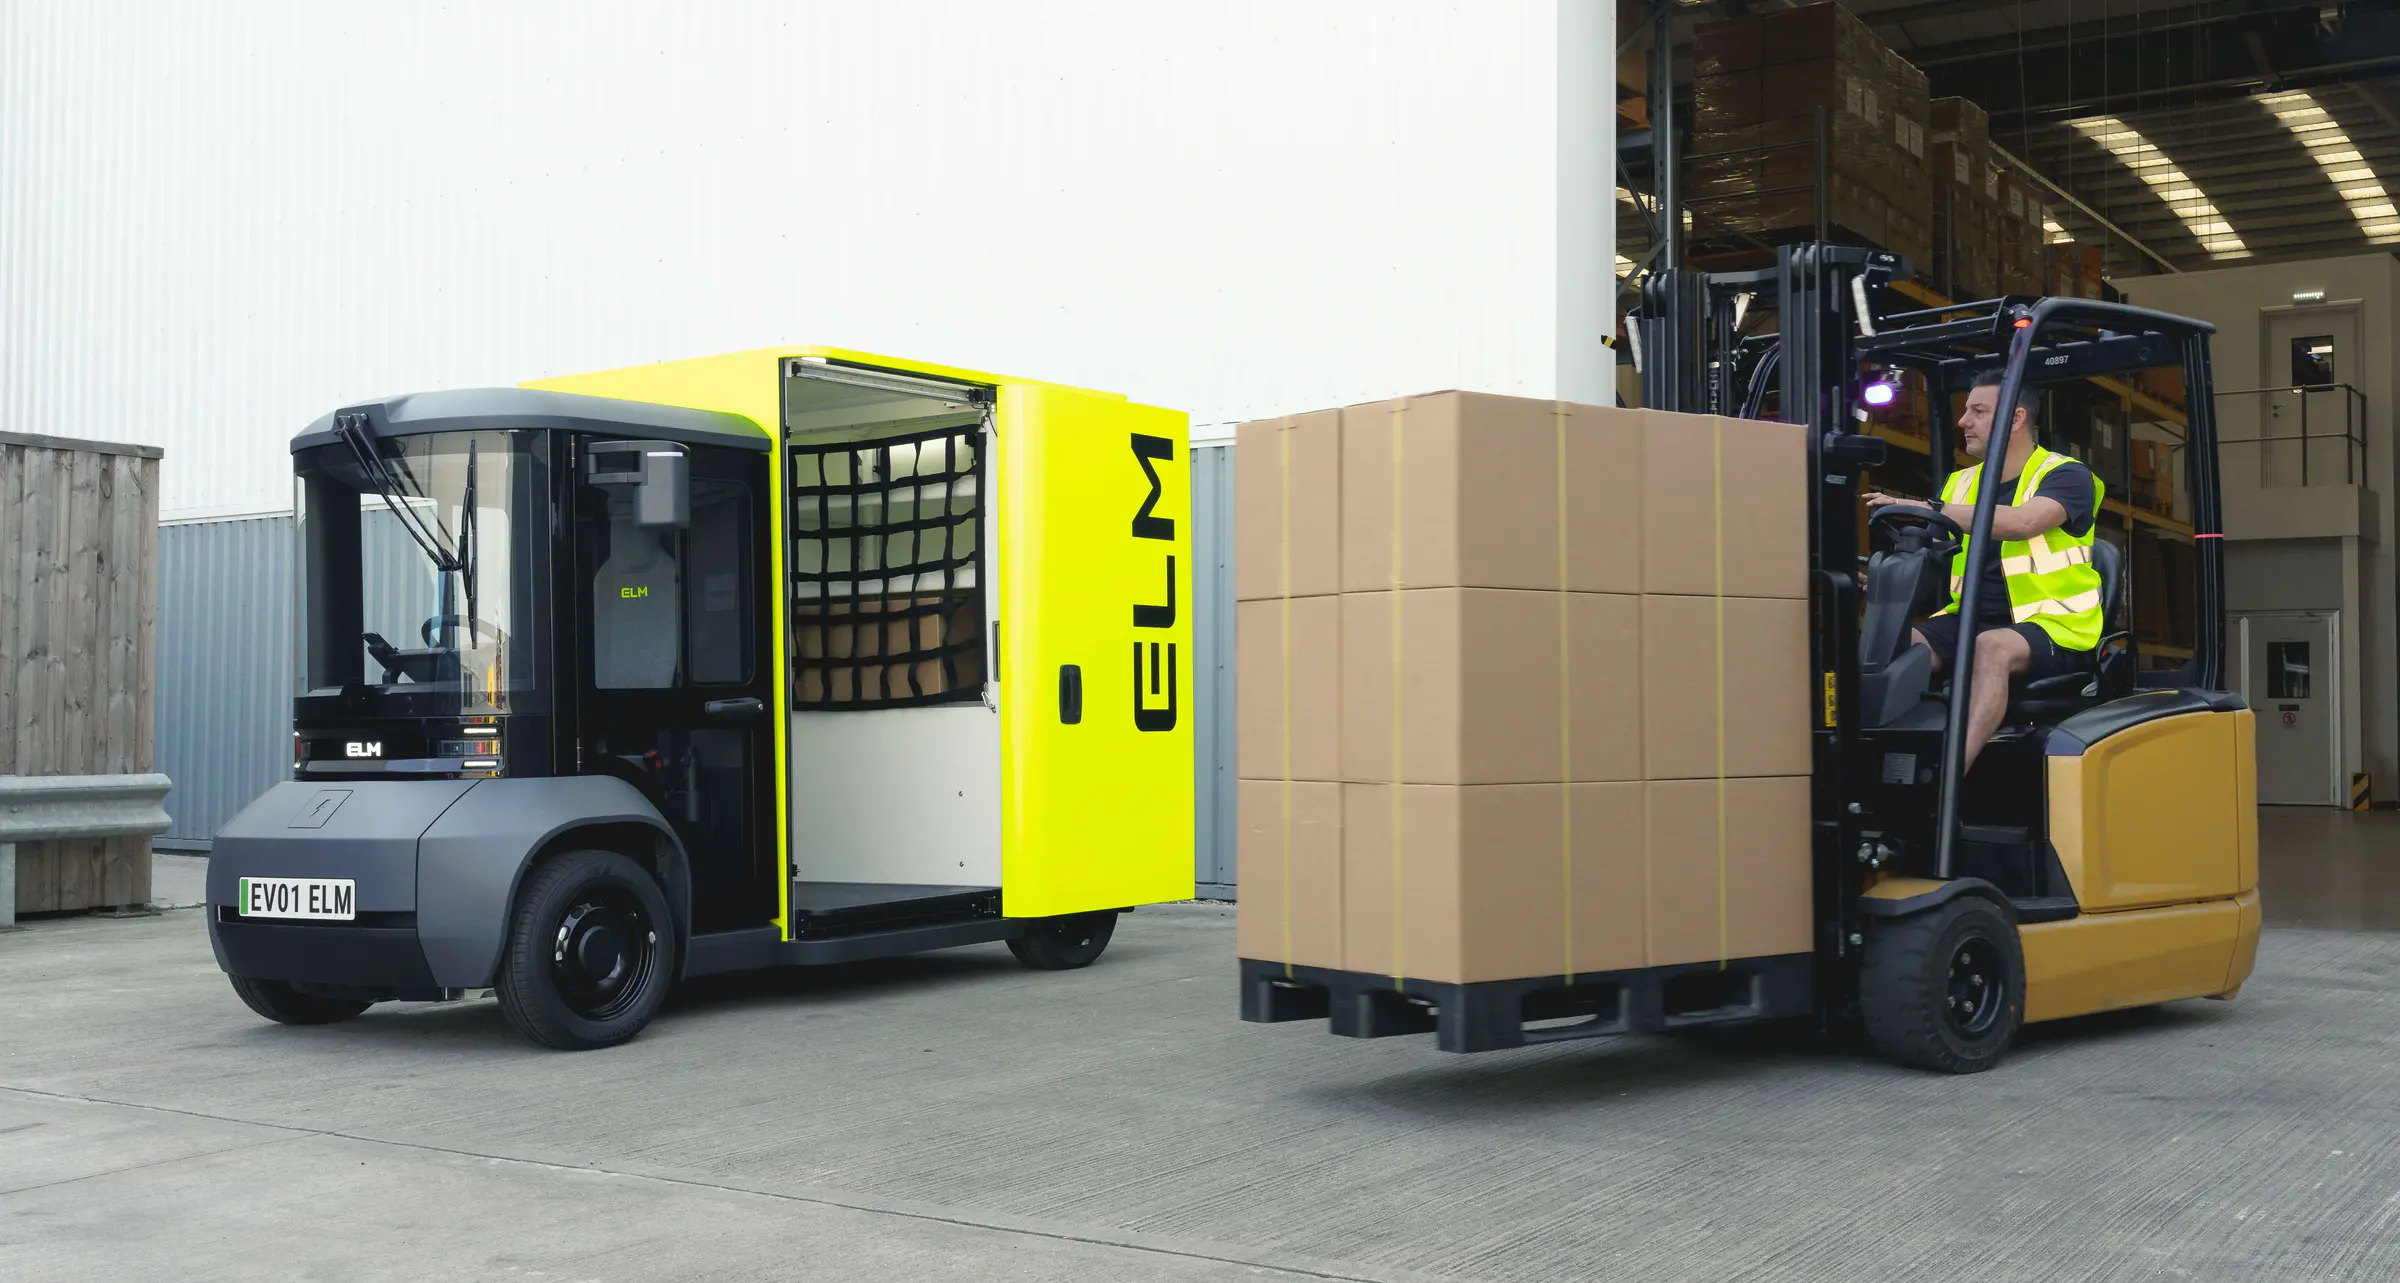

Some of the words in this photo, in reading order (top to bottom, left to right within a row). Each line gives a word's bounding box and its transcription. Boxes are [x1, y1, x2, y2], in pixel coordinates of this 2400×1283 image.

[2044, 355, 2069, 366] 40897
[1130, 432, 1177, 732] ELM
[621, 586, 648, 598] ELM
[346, 741, 381, 757] ELM
[251, 883, 299, 912] EV01
[309, 884, 351, 914] ELM
